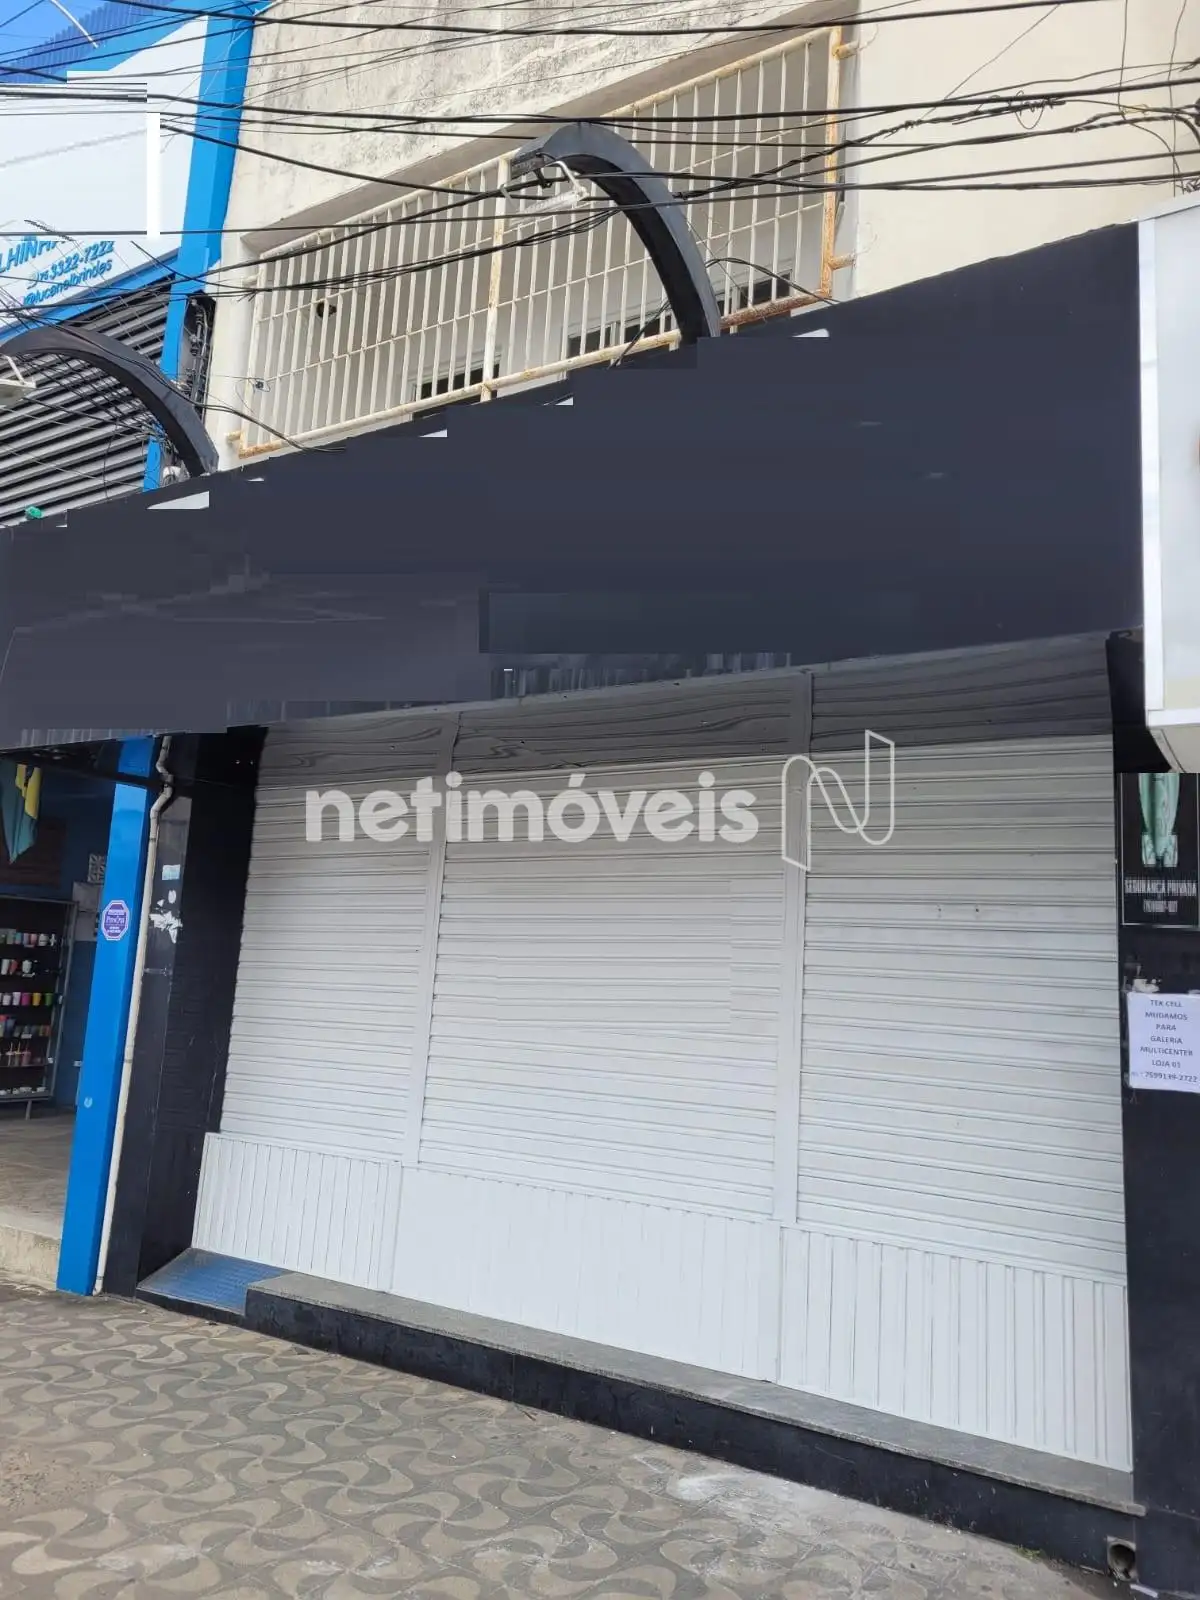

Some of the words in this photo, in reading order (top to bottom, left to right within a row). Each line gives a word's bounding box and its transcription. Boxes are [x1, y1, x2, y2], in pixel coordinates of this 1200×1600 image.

[1145, 1011, 1188, 1021] MUDAMOS
[1155, 1023, 1177, 1031] PARA
[1150, 1035, 1183, 1045] GALERIA
[1140, 1046, 1194, 1057] MULTICENTER
